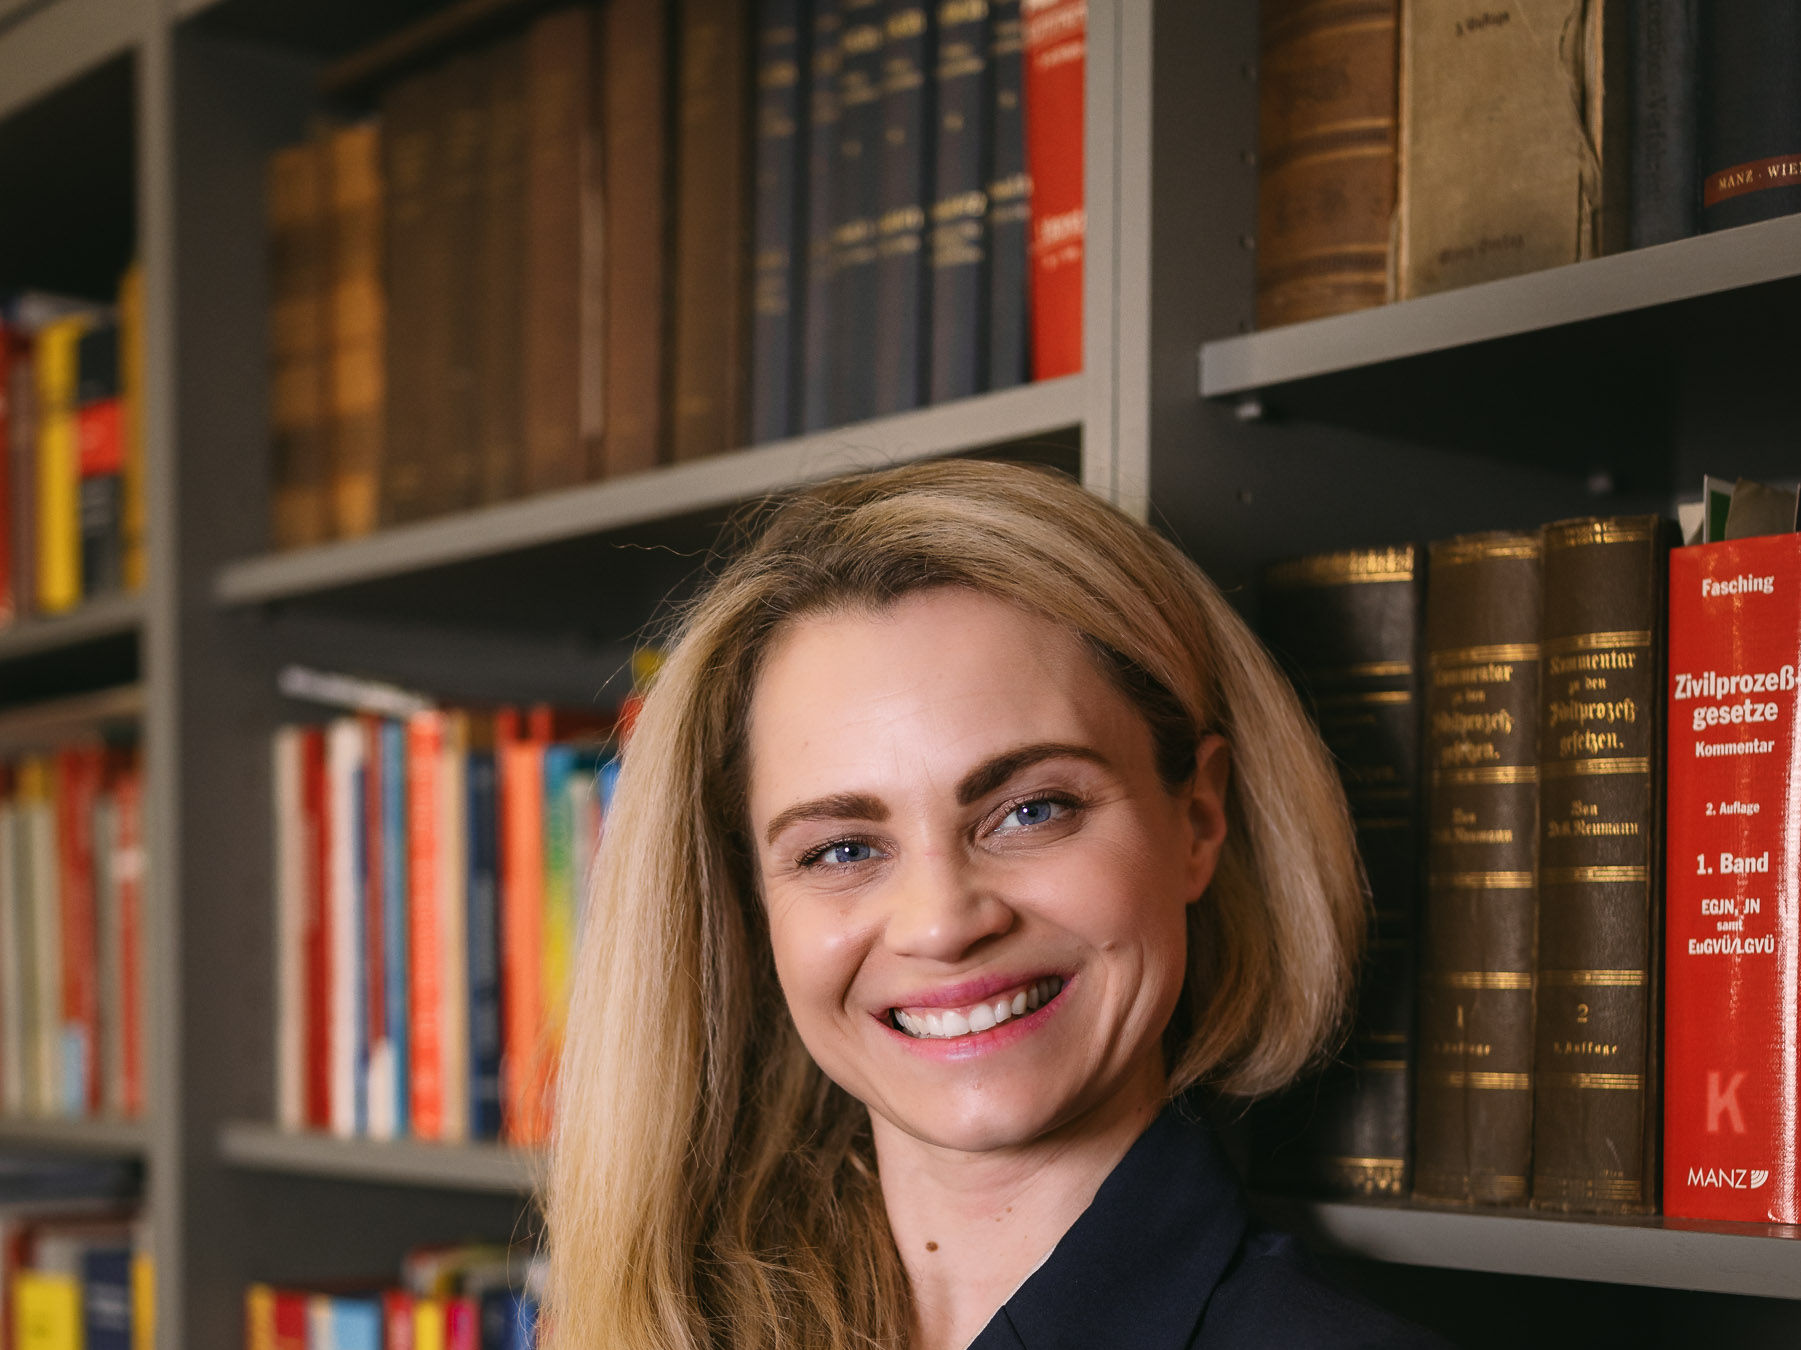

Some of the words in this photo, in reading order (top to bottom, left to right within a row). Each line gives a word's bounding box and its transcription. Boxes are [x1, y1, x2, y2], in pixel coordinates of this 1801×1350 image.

[1719, 168, 1754, 190] MANZ
[1767, 161, 1801, 179] WIE
[1702, 573, 1775, 598] Fasching
[1692, 698, 1779, 731] gesetze
[1695, 738, 1775, 758] Kommentar
[1705, 802, 1717, 816] 2.
[1719, 801, 1760, 816] Auflage
[1696, 853, 1713, 875] 1.
[1719, 852, 1769, 875] Band
[1701, 898, 1739, 916] EGJN,
[1743, 898, 1760, 914] JN
[1716, 918, 1743, 932] samt
[1577, 1003, 1589, 1023] 2
[1707, 1070, 1746, 1134] K
[1687, 1166, 1748, 1190] MANZ
